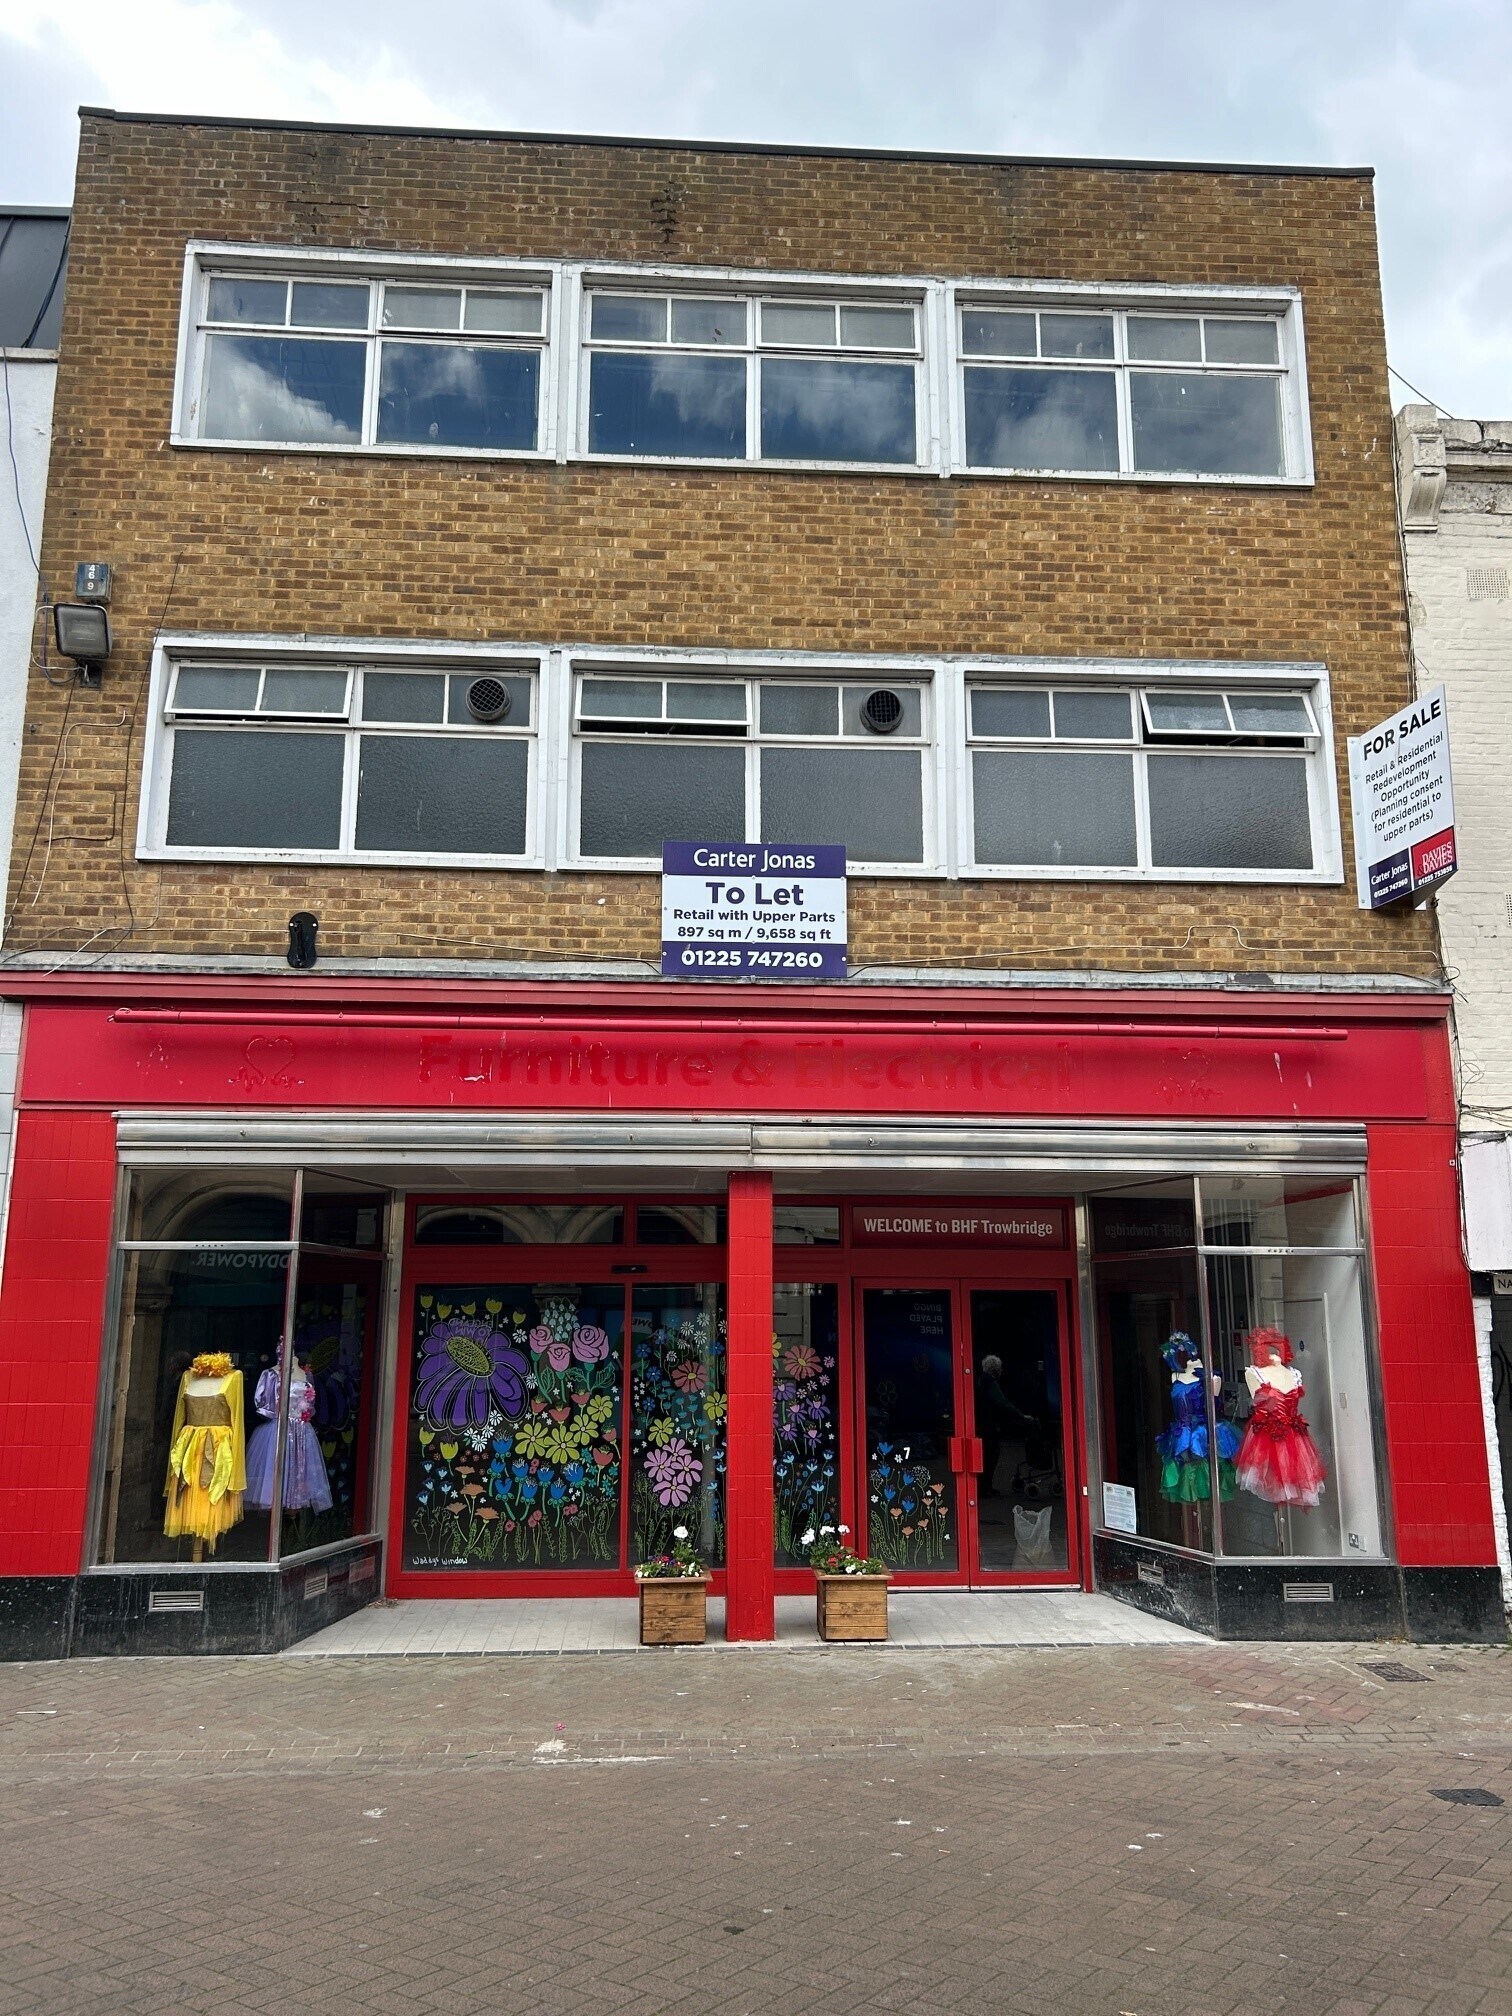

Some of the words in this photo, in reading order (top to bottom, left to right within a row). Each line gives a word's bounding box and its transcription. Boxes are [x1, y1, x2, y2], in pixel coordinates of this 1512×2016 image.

[1363, 728, 1396, 761] FOR
[1399, 699, 1442, 739] SALE
[1365, 765, 1388, 785] Retail
[1389, 760, 1396, 770] &
[1397, 731, 1443, 766] Residential
[1373, 750, 1437, 794] Redevelopment
[1380, 769, 1430, 802] Opportunity
[1371, 795, 1408, 822] (Planning
[1410, 775, 1443, 800] consent
[1374, 821, 1386, 834] for
[1387, 799, 1430, 827] residential
[1432, 791, 1442, 802] to
[1383, 822, 1407, 843] upper
[1409, 809, 1434, 832] parts)
[693, 848, 756, 868] Carter
[760, 850, 816, 872] Jonas
[1422, 841, 1453, 863] DAVIES
[1423, 852, 1454, 874] DAVIES
[1371, 870, 1391, 885] Carter
[1391, 863, 1409, 879] Jonas
[705, 882, 745, 905] To
[755, 883, 804, 906] Let
[673, 909, 714, 921] Retail
[718, 910, 748, 921] with
[752, 910, 796, 924] Upper
[800, 911, 836, 923] Parts
[677, 926, 704, 938] 897
[708, 928, 724, 940] sq
[728, 929, 742, 938] m
[757, 927, 796, 941] 9,658
[799, 930, 816, 942] sq
[820, 929, 832, 940] ft
[681, 950, 742, 966] 01225
[747, 951, 823, 968] 747260
[418, 1034, 714, 1087] Furniture
[732, 1038, 775, 1087] &
[864, 1218, 932, 1233] WELCOME
[935, 1220, 948, 1233] to
[951, 1219, 979, 1234] BHF
[981, 1219, 1053, 1237] Trowbridge
